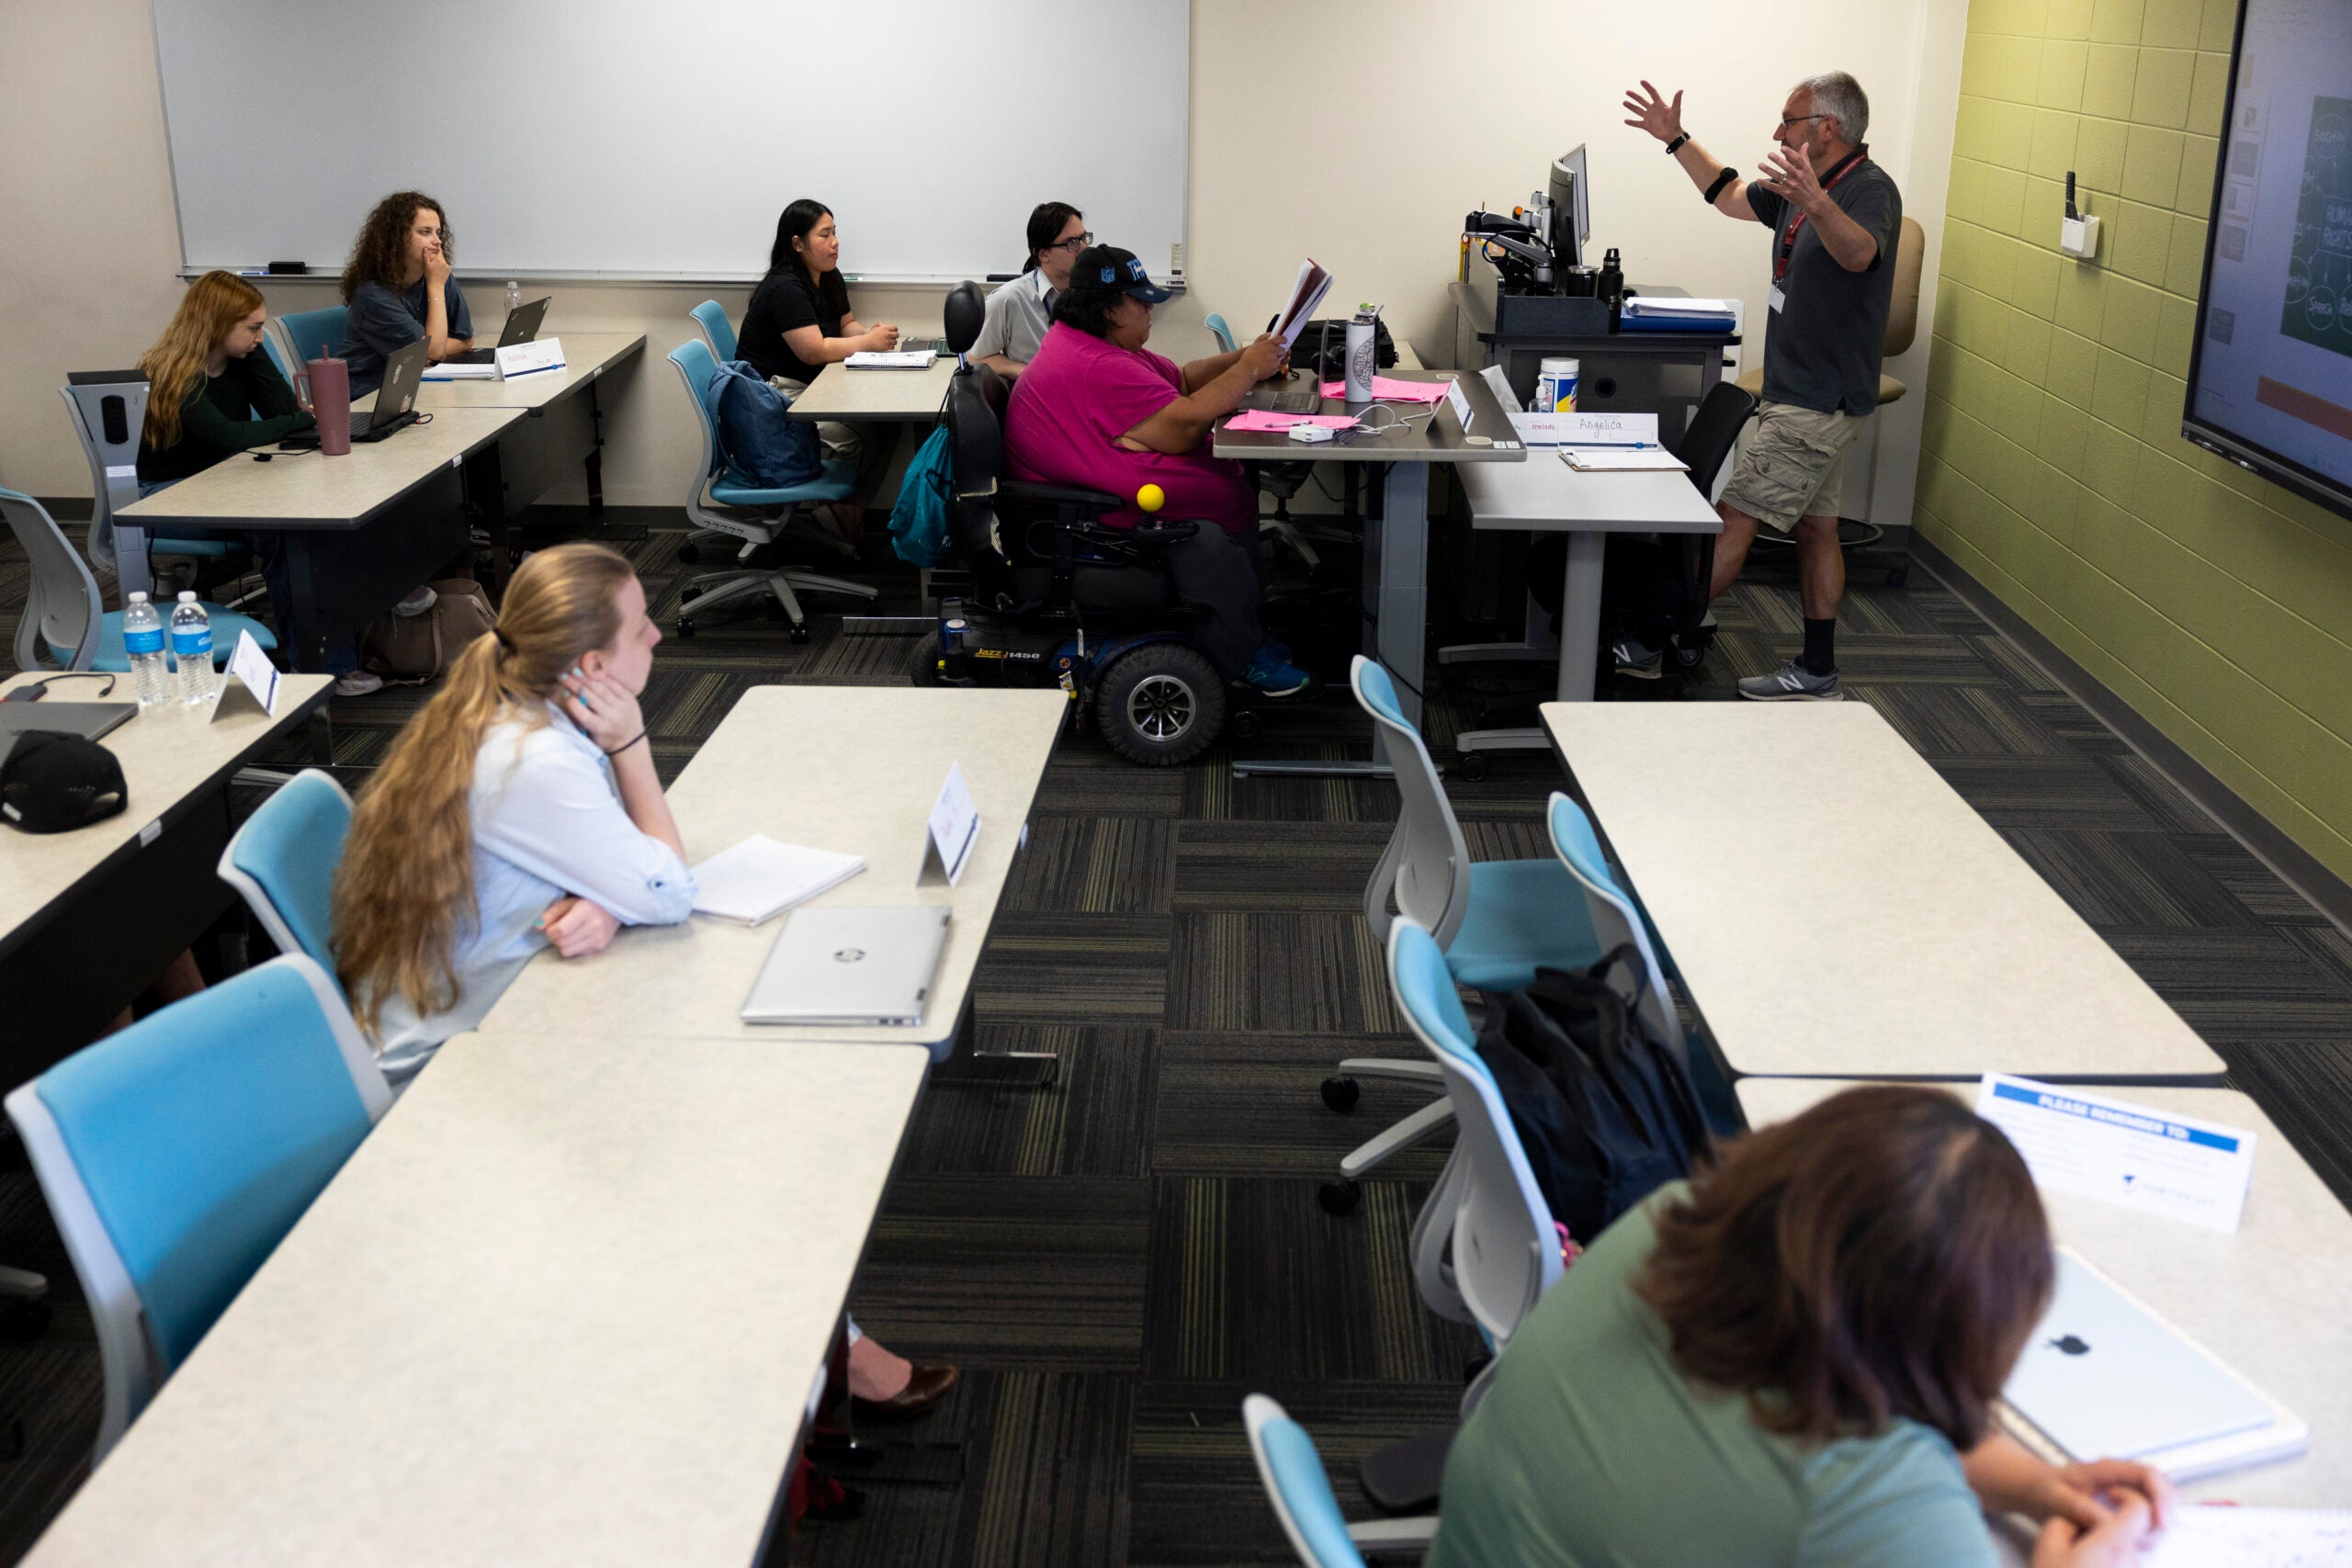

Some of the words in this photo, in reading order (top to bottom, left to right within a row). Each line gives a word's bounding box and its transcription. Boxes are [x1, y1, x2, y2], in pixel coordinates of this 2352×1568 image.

[1532, 423, 1555, 431] melody
[1579, 418, 1623, 439] Angelica
[1777, 674, 1805, 691] N
[2038, 1093, 2088, 1117] PLEASE
[2089, 1105, 2165, 1135] REMEMBER
